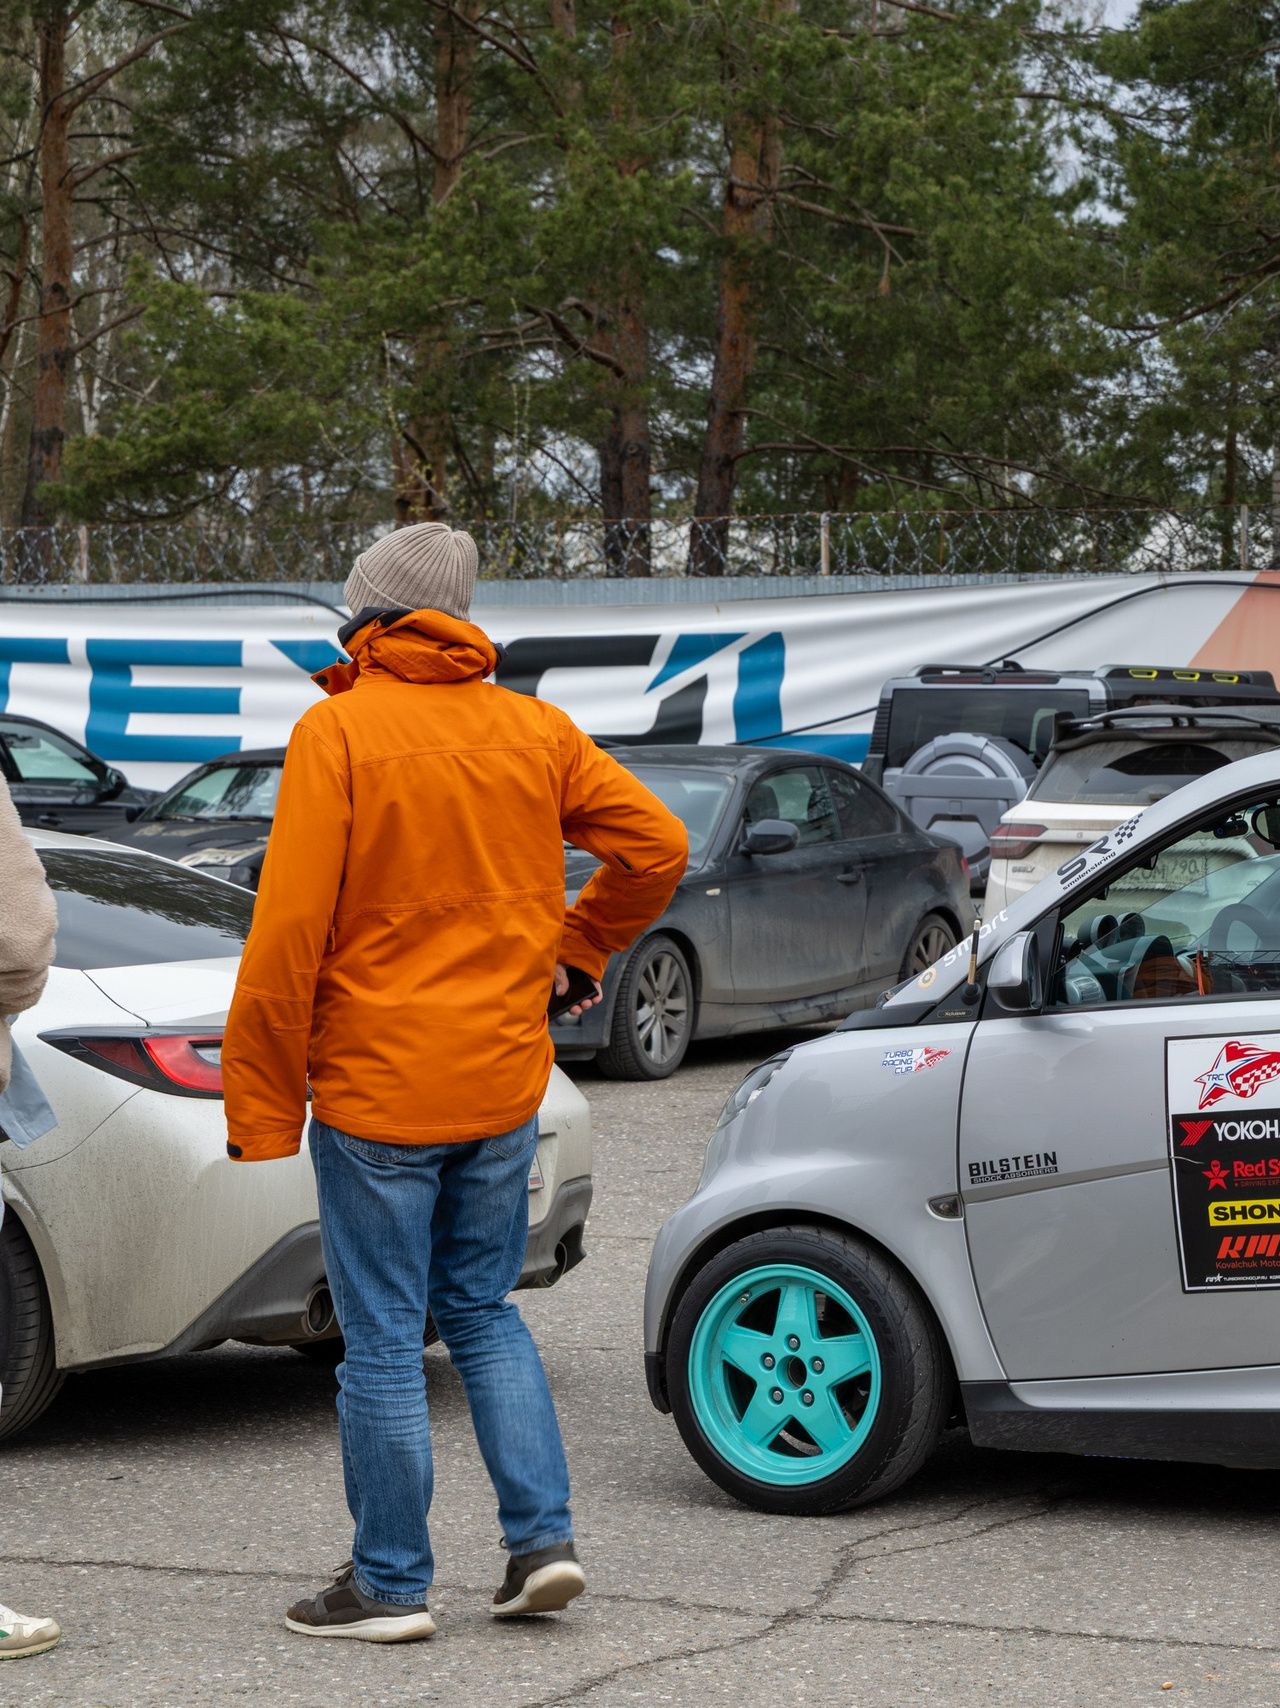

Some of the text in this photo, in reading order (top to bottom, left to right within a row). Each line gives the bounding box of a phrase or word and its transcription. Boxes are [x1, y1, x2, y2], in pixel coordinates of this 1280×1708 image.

[943, 908, 1009, 967] smart
[884, 1049, 914, 1059] TURBO
[881, 1057, 914, 1067] RACING
[894, 1066, 913, 1075] CUP
[1206, 1073, 1224, 1081] TRC
[968, 1151, 1057, 1177] BILSTEIN
[1233, 1160, 1267, 1178] Red
[973, 1166, 1056, 1184] SHOCK ABSORBERS
[1240, 1180, 1267, 1188] DRIVING
[1215, 1260, 1258, 1270] Kovalchuk
